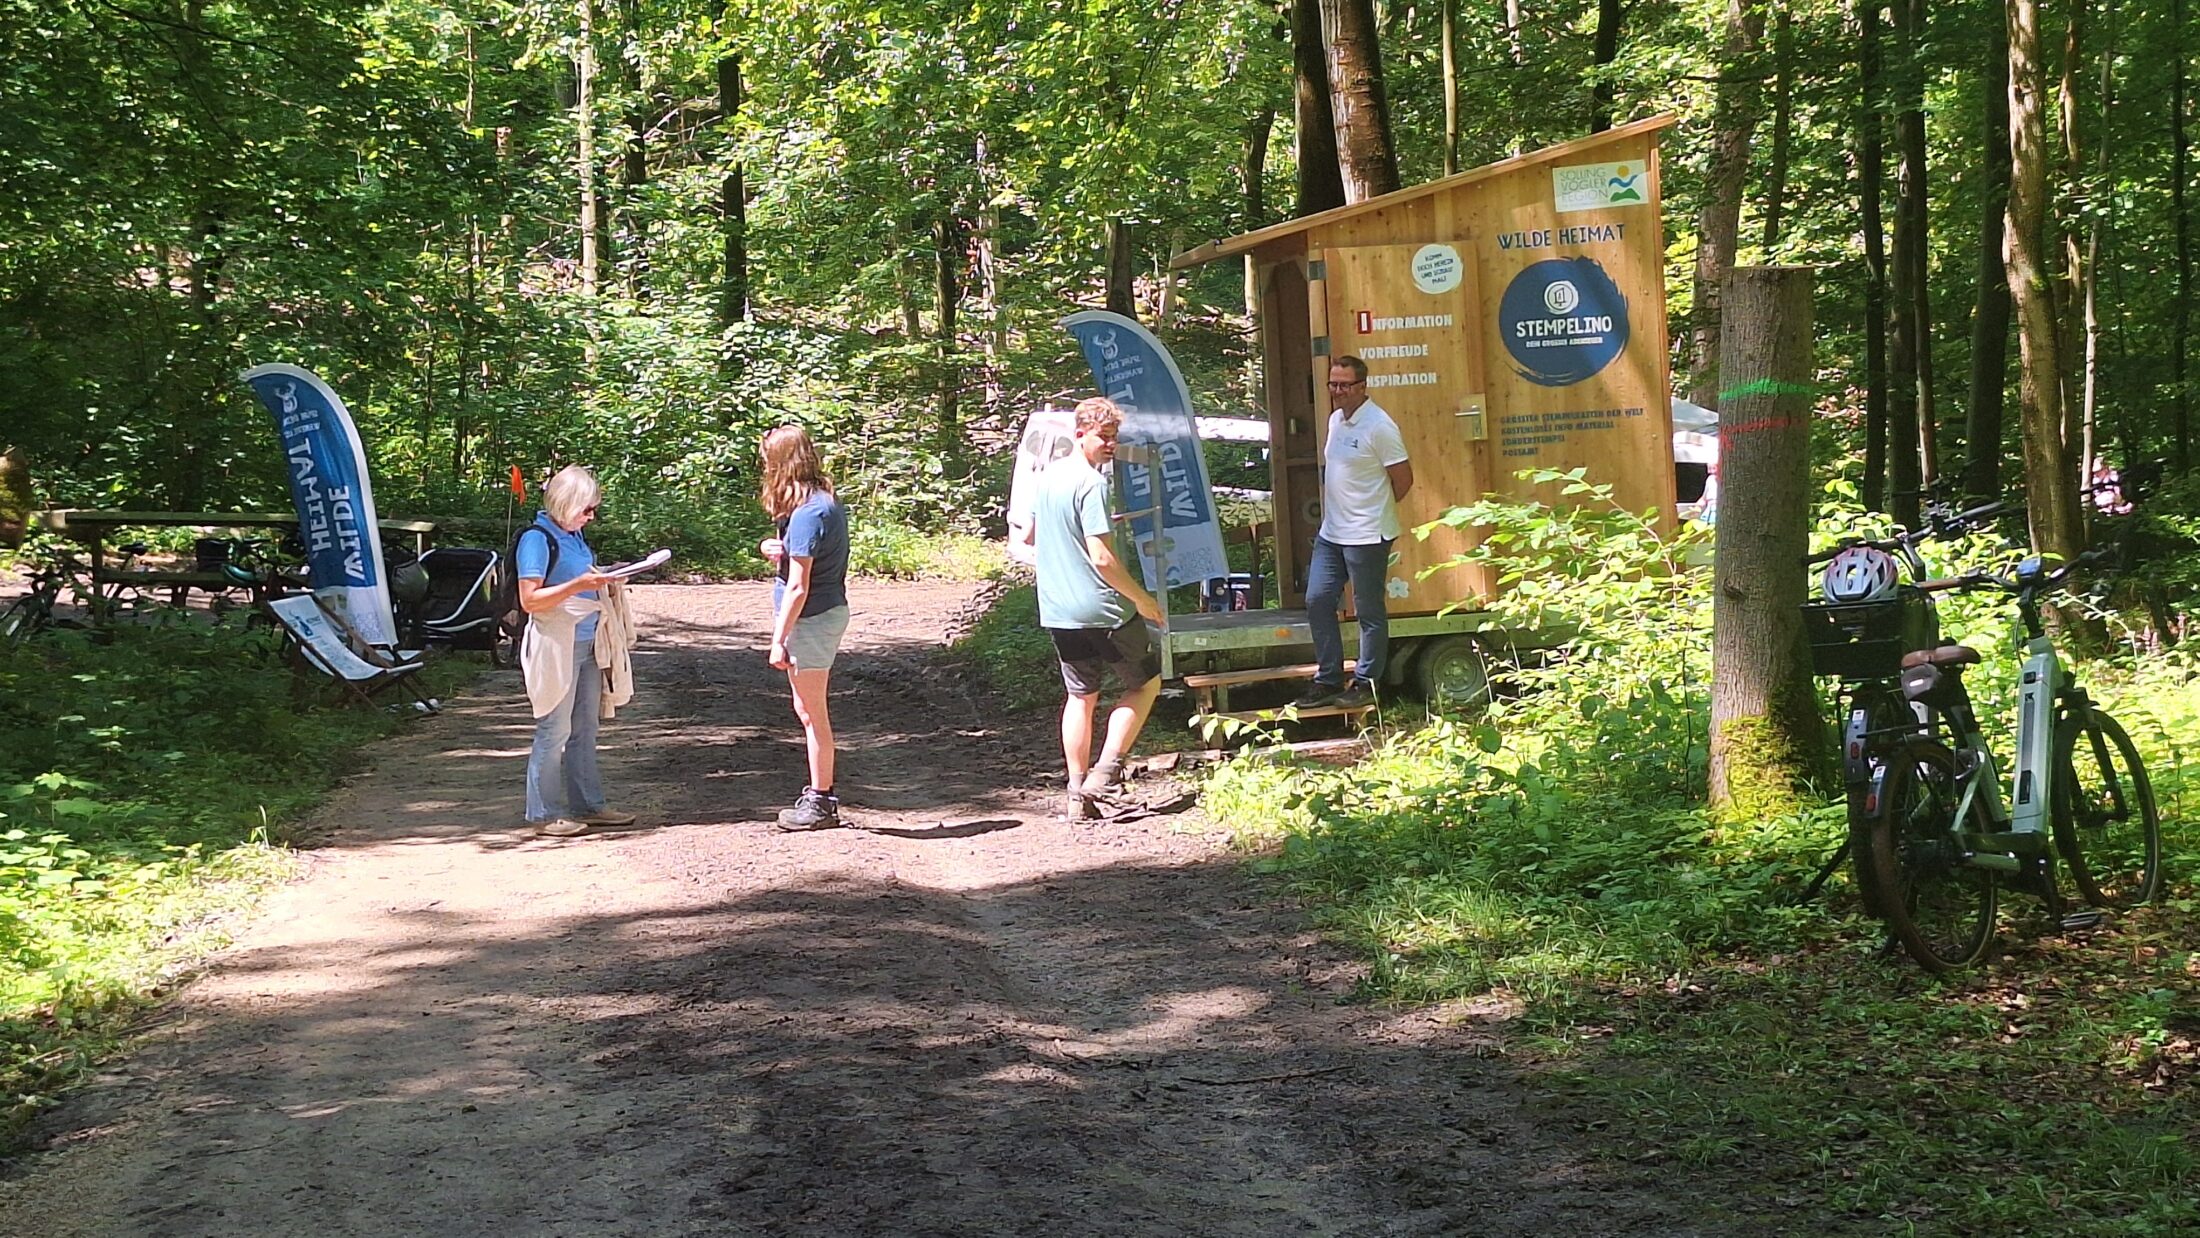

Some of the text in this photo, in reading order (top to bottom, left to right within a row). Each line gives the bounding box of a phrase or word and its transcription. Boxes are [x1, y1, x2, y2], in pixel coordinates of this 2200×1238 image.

[1560, 167, 1606, 181] SOLLING
[1560, 178, 1608, 191] VOGLER
[1497, 224, 1624, 250] WILDE HEIMAT
[1360, 312, 1453, 331] INFORMATION
[1516, 315, 1613, 337] STEMPELINO
[1359, 344, 1429, 359] VORFREUDE
[1366, 372, 1437, 388] NSPIRATION
